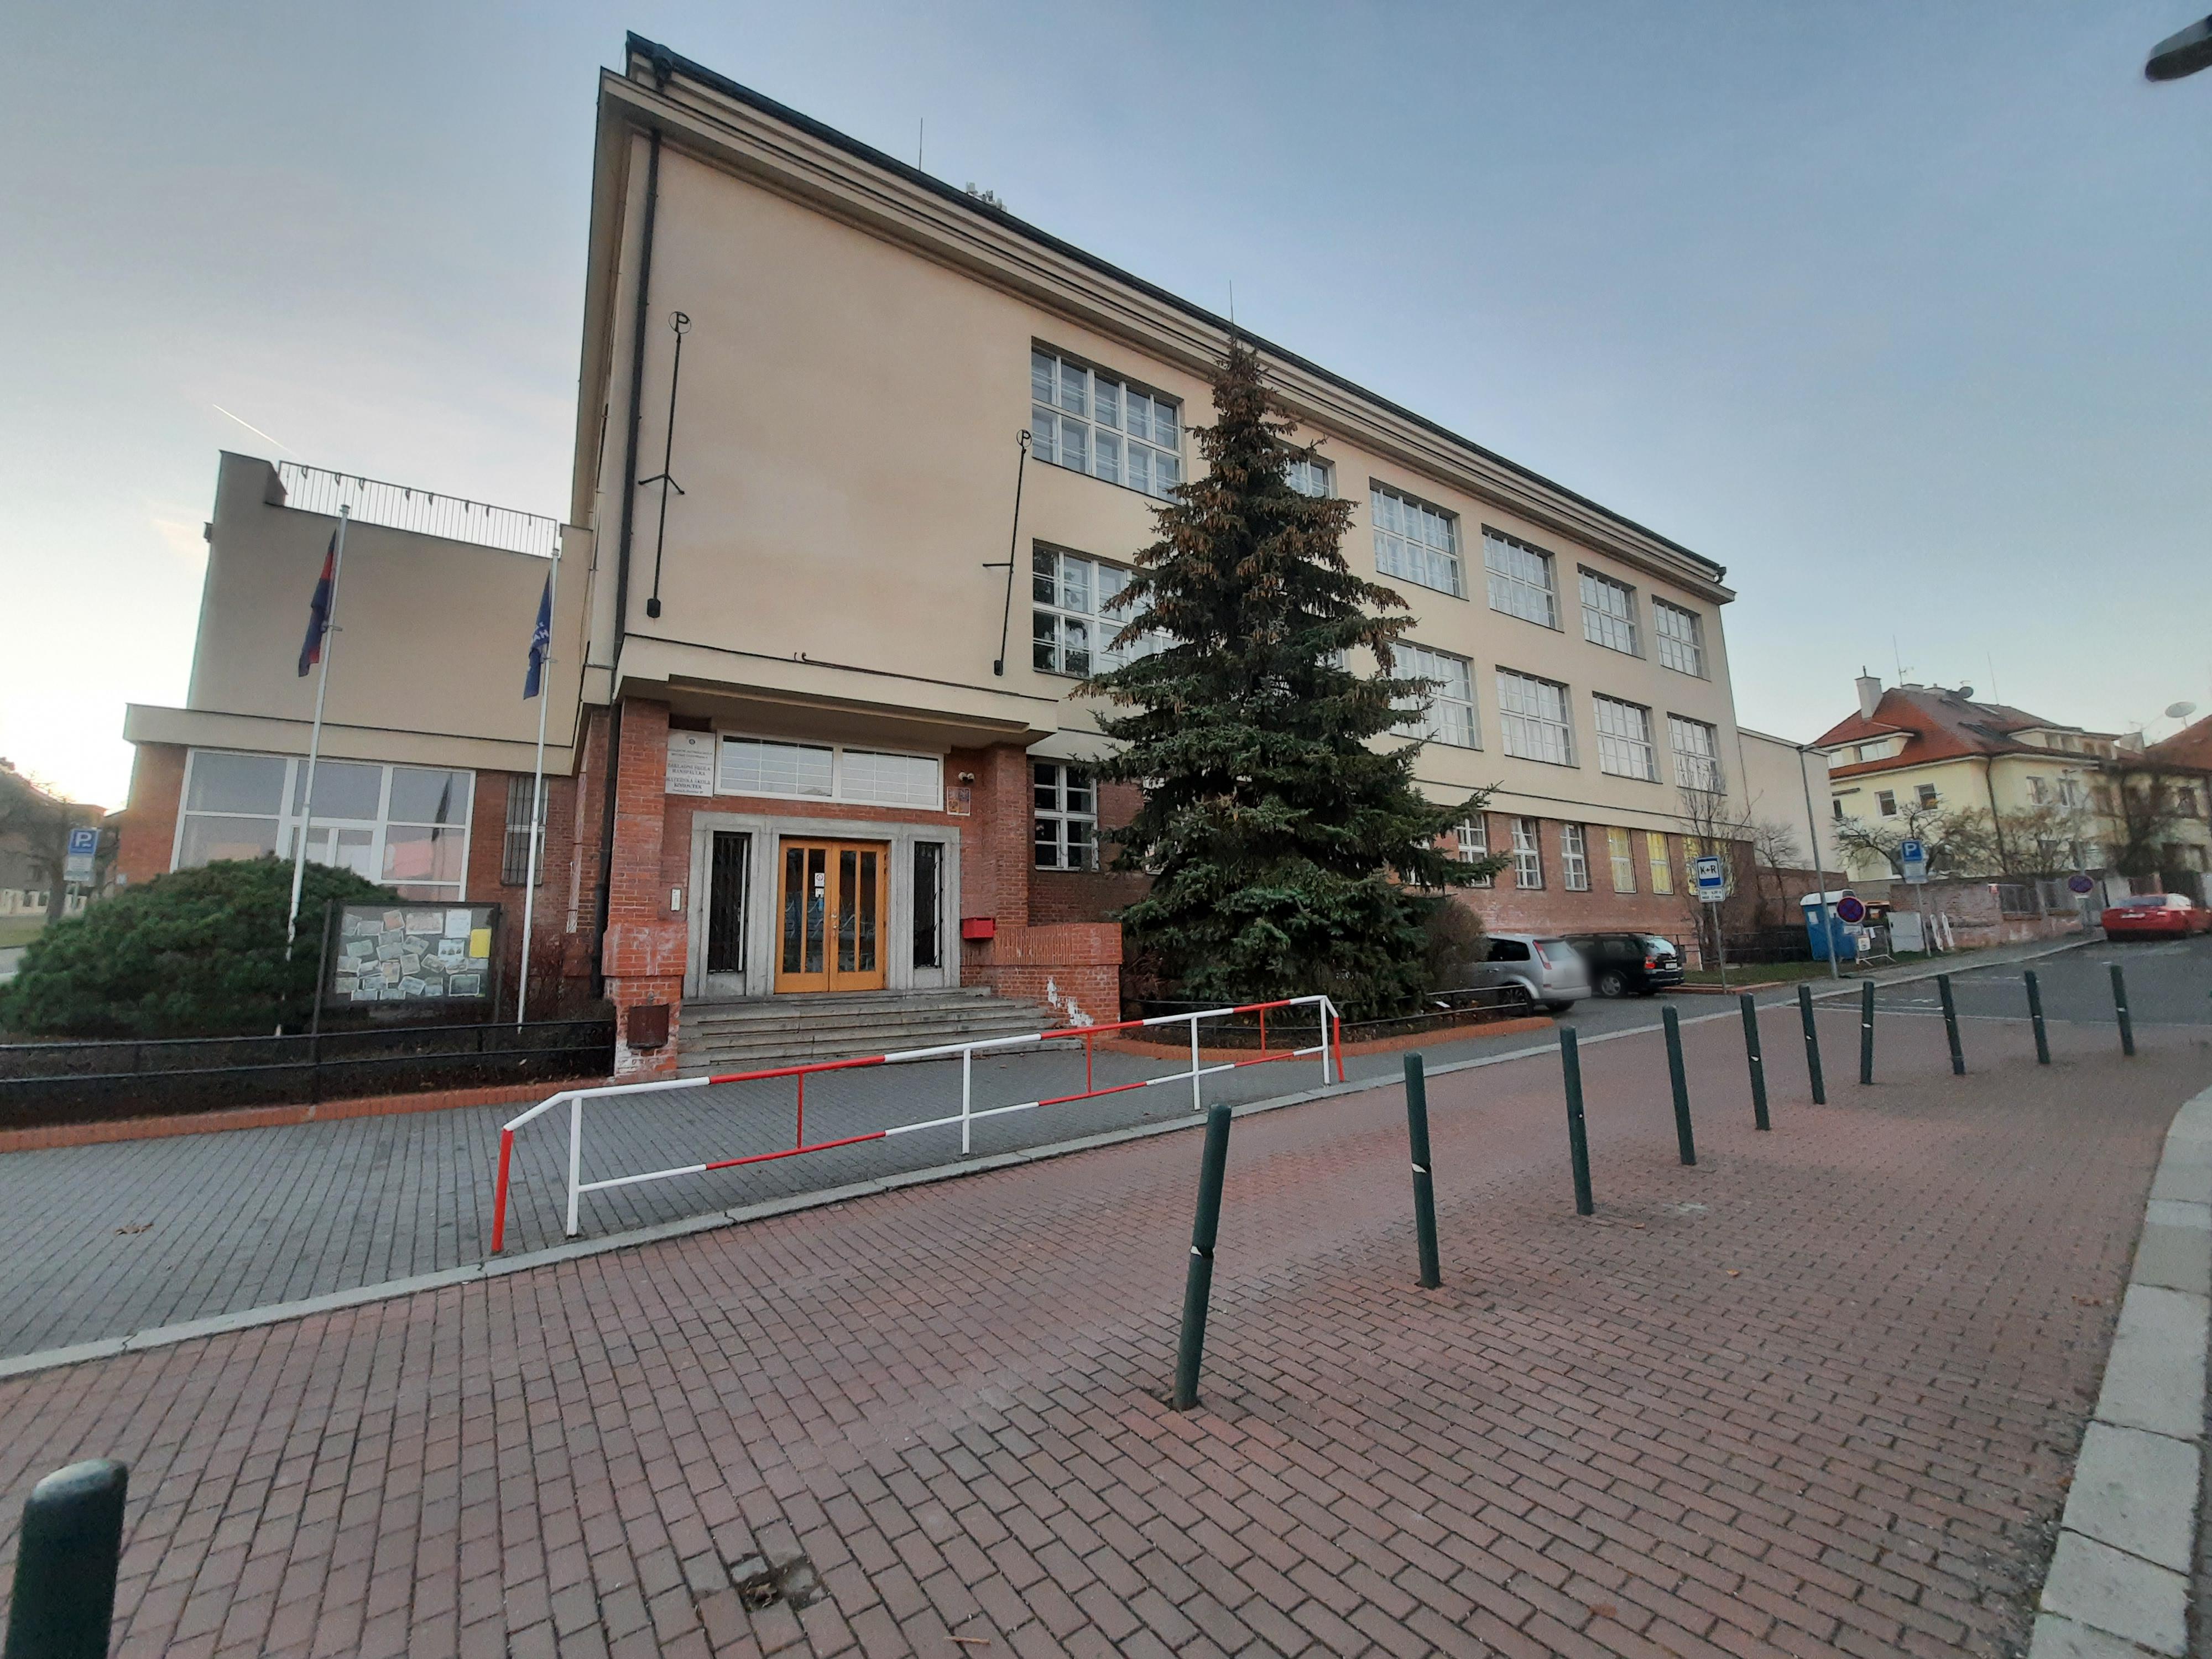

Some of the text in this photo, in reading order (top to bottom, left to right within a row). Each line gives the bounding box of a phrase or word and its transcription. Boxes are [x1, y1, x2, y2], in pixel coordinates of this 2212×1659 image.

[75, 831, 92, 847] P
[1904, 843, 1917, 856] P
[1700, 865, 1717, 875] K+R
